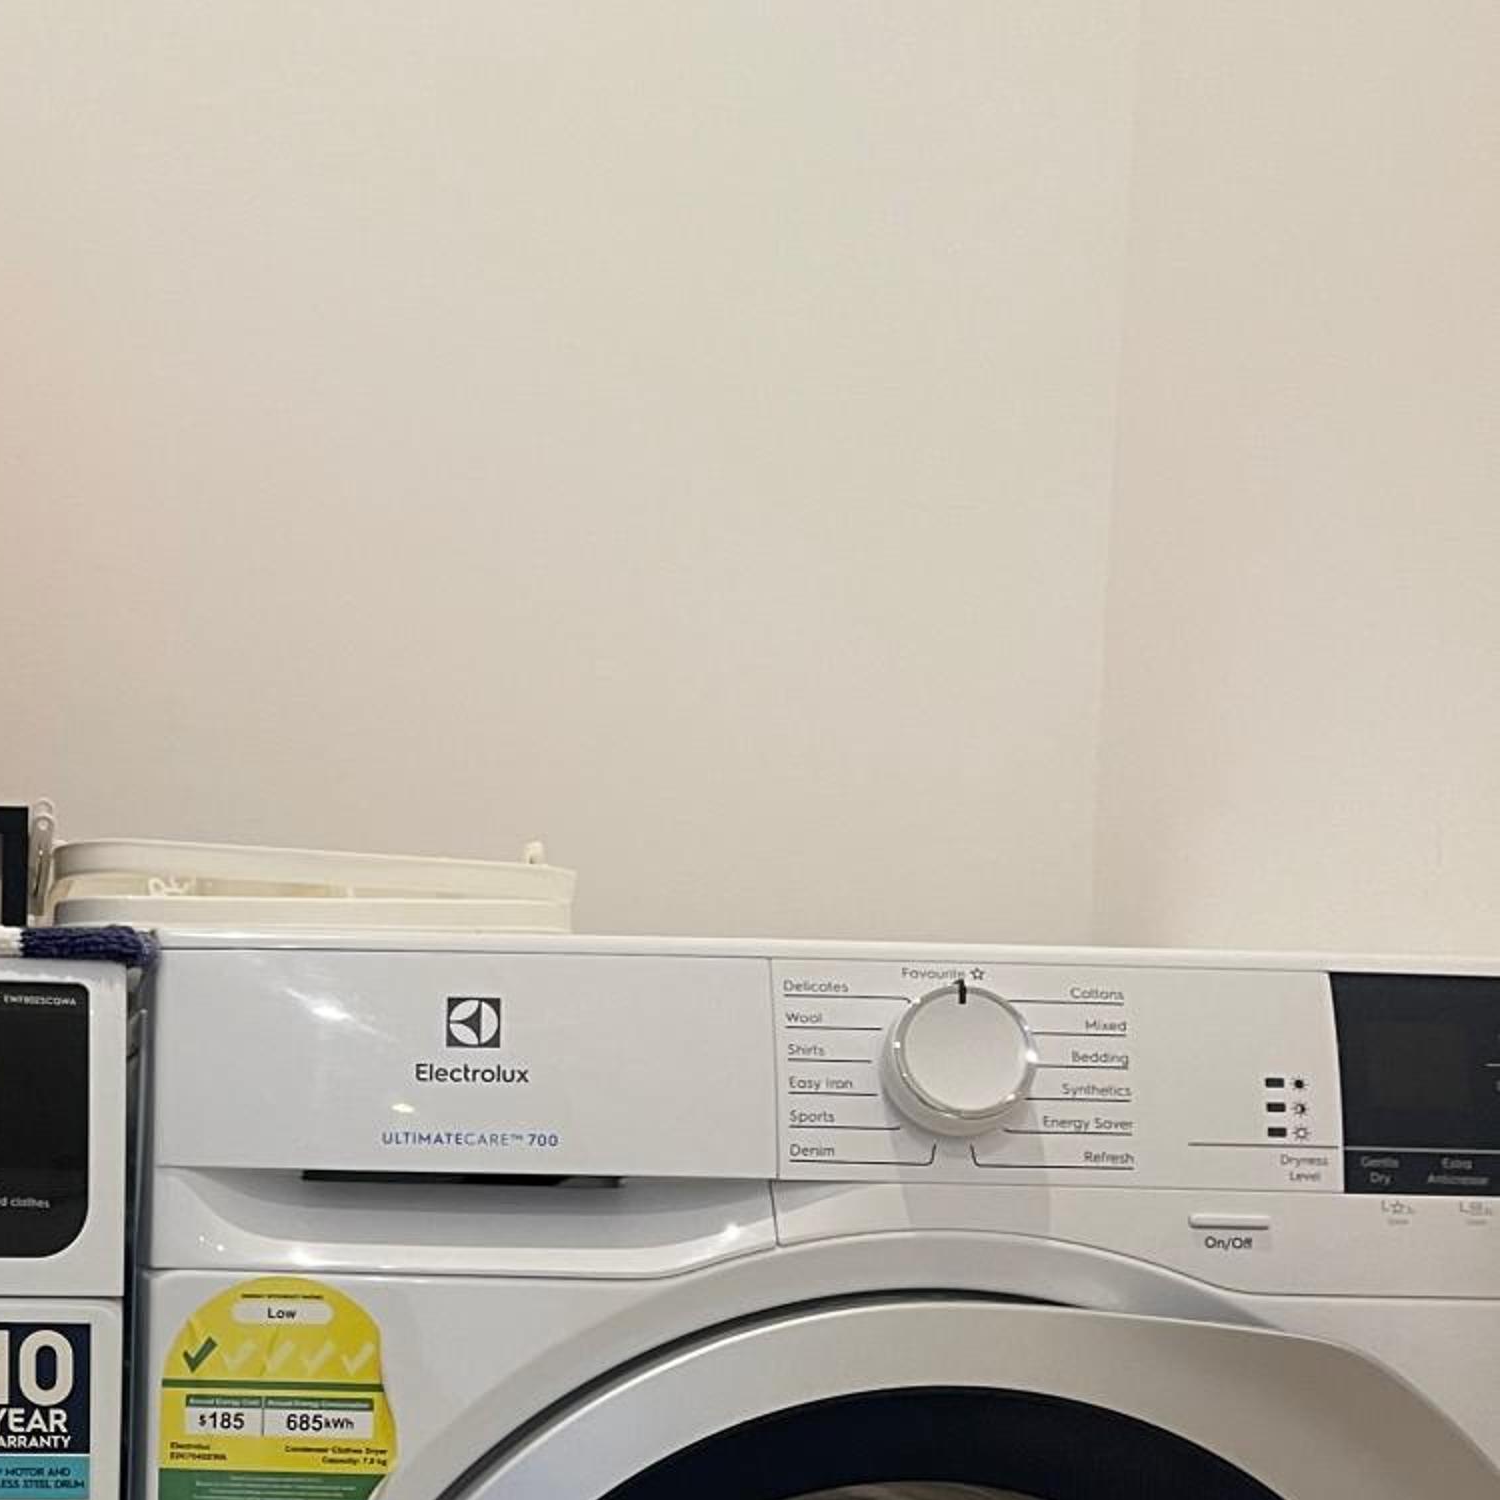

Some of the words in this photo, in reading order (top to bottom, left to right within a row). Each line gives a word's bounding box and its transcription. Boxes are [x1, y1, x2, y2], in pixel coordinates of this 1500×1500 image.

[902, 967, 966, 979] Favourite
[783, 980, 849, 993] Delicates
[1069, 987, 1124, 1000] Cottons
[786, 1012, 822, 1023] Wool
[1085, 1020, 1127, 1032] Mixed
[788, 1044, 825, 1056] Shirts
[1071, 1051, 1129, 1068] Bedding
[415, 1063, 529, 1083] Electrolux
[788, 1076, 821, 1091] Easy
[1061, 1083, 1132, 1097] Synthetics
[789, 1109, 835, 1124] Sports
[1043, 1115, 1090, 1131] Energy
[1094, 1117, 1134, 1130] Saver
[528, 1133, 559, 1147] 700
[789, 1143, 835, 1157] Denim
[1083, 1151, 1135, 1165] Refresh
[1290, 1171, 1321, 1182] Level
[1369, 1171, 1391, 1185] Dry
[1204, 1236, 1253, 1251] On/Off
[267, 1307, 297, 1320] Low
[199, 1411, 245, 1430] $185
[4, 1467, 45, 1477] MOTOR
[47, 1467, 71, 1477] AND
[54, 1479, 85, 1489] DRUM
